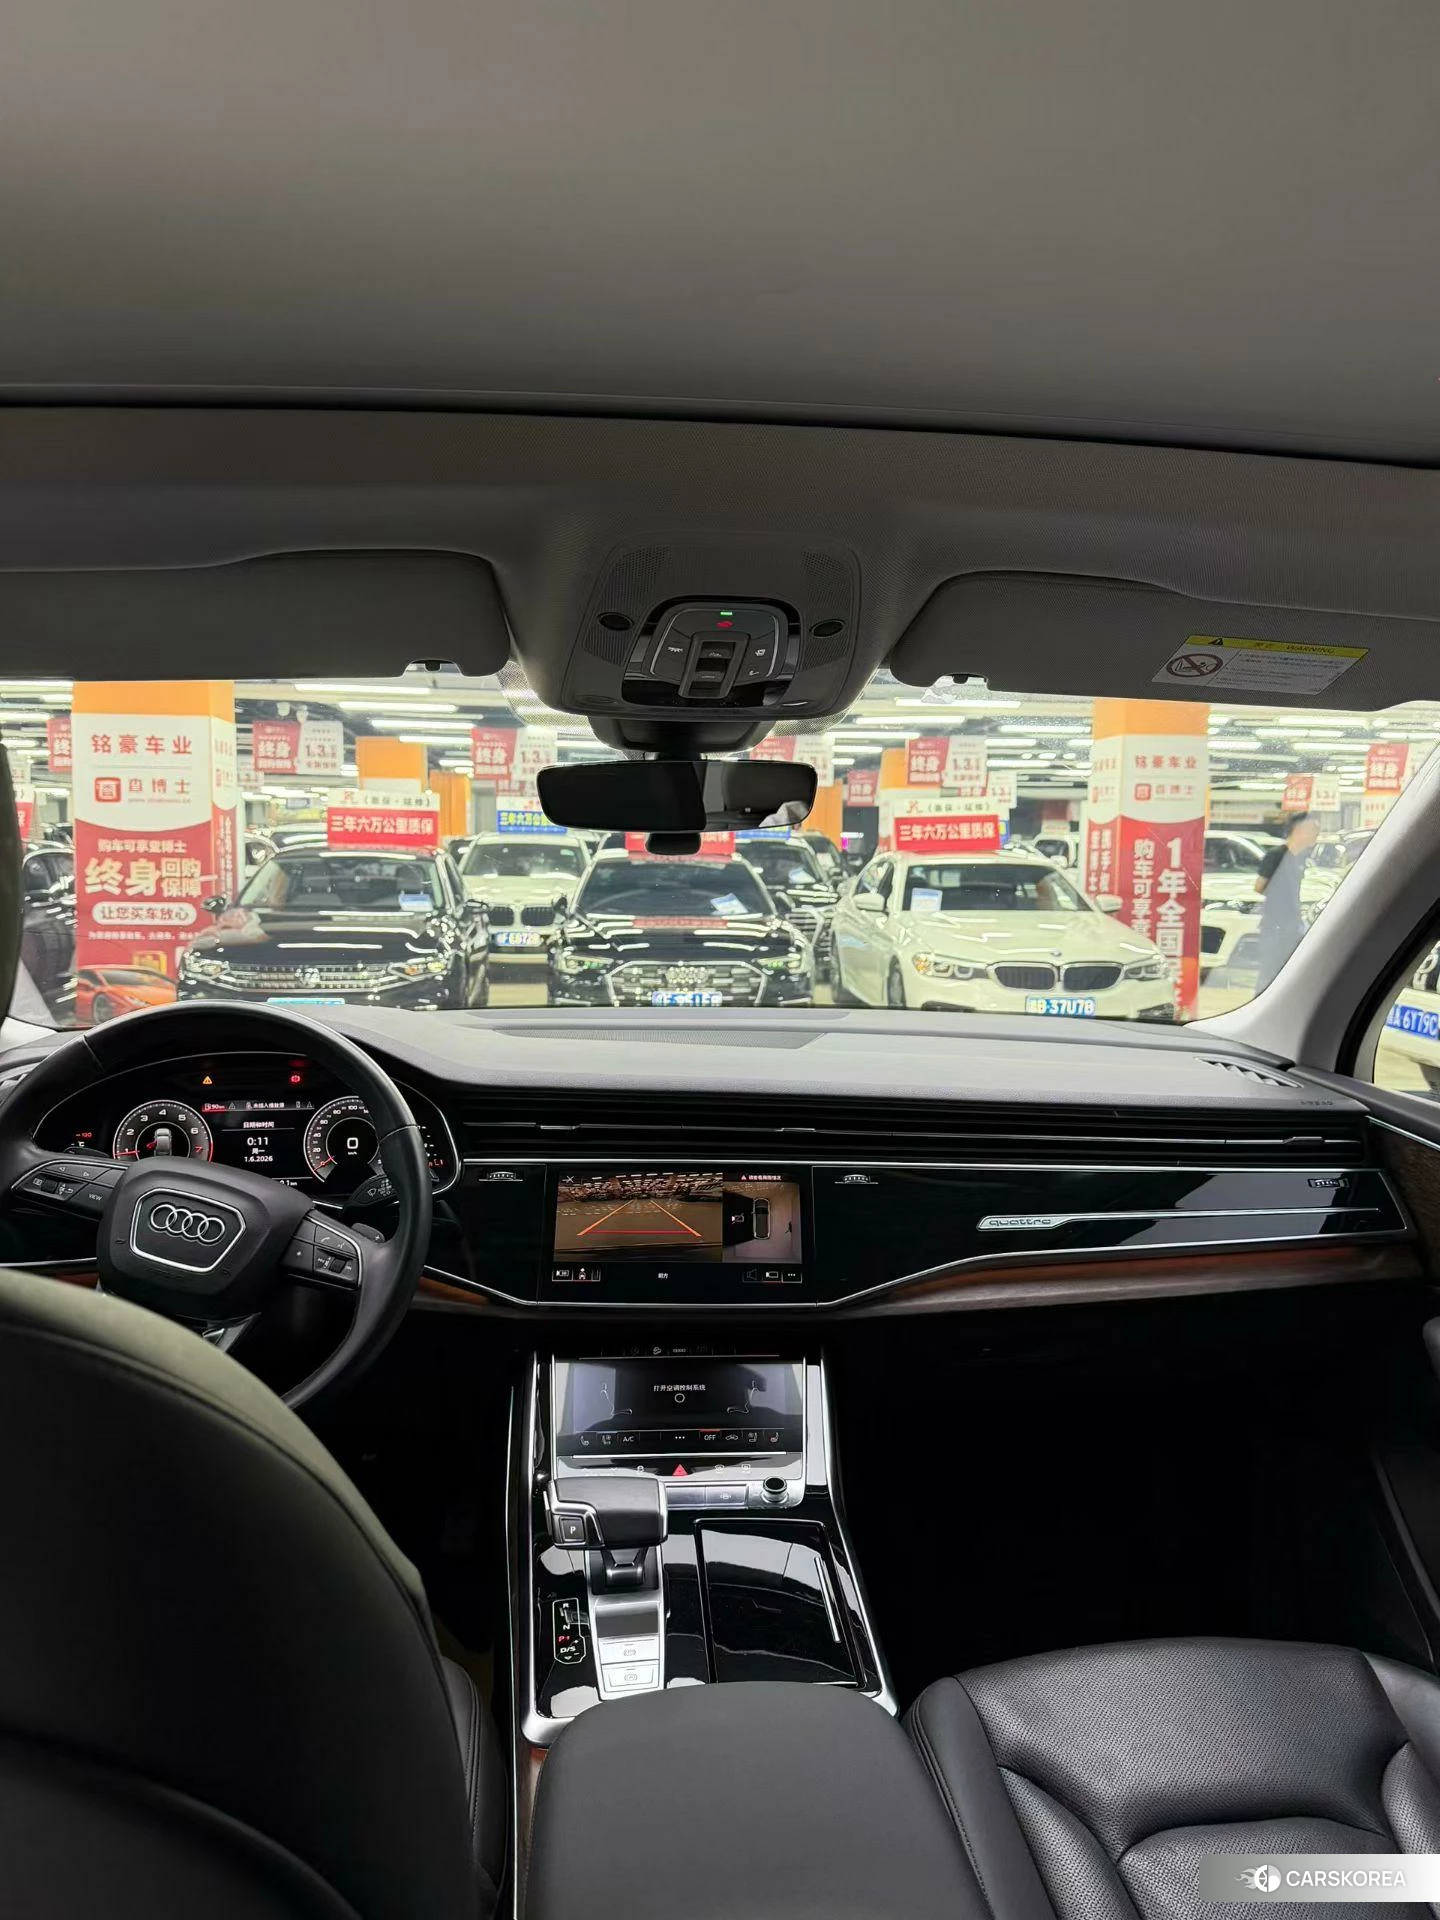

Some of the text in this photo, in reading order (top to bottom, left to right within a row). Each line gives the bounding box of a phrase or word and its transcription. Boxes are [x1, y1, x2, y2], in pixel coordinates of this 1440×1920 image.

[91, 734, 192, 755] 铭豪车业
[330, 815, 435, 835] 三年六万公里质保
[899, 821, 996, 842] 三年六万公里质保
[84, 857, 161, 897] 终身
[101, 905, 189, 921] 让您买车放心
[126, 1128, 135, 1136] 2
[190, 1127, 199, 1135] 6
[247, 1137, 269, 1146] 0:11
[346, 1137, 359, 1150] 0
[988, 1218, 1051, 1227] quattro
[653, 1384, 707, 1392] 打开空调控制系统
[622, 1435, 635, 1443] A/C
[570, 1525, 577, 1535] P
[560, 1645, 576, 1653] D/S
